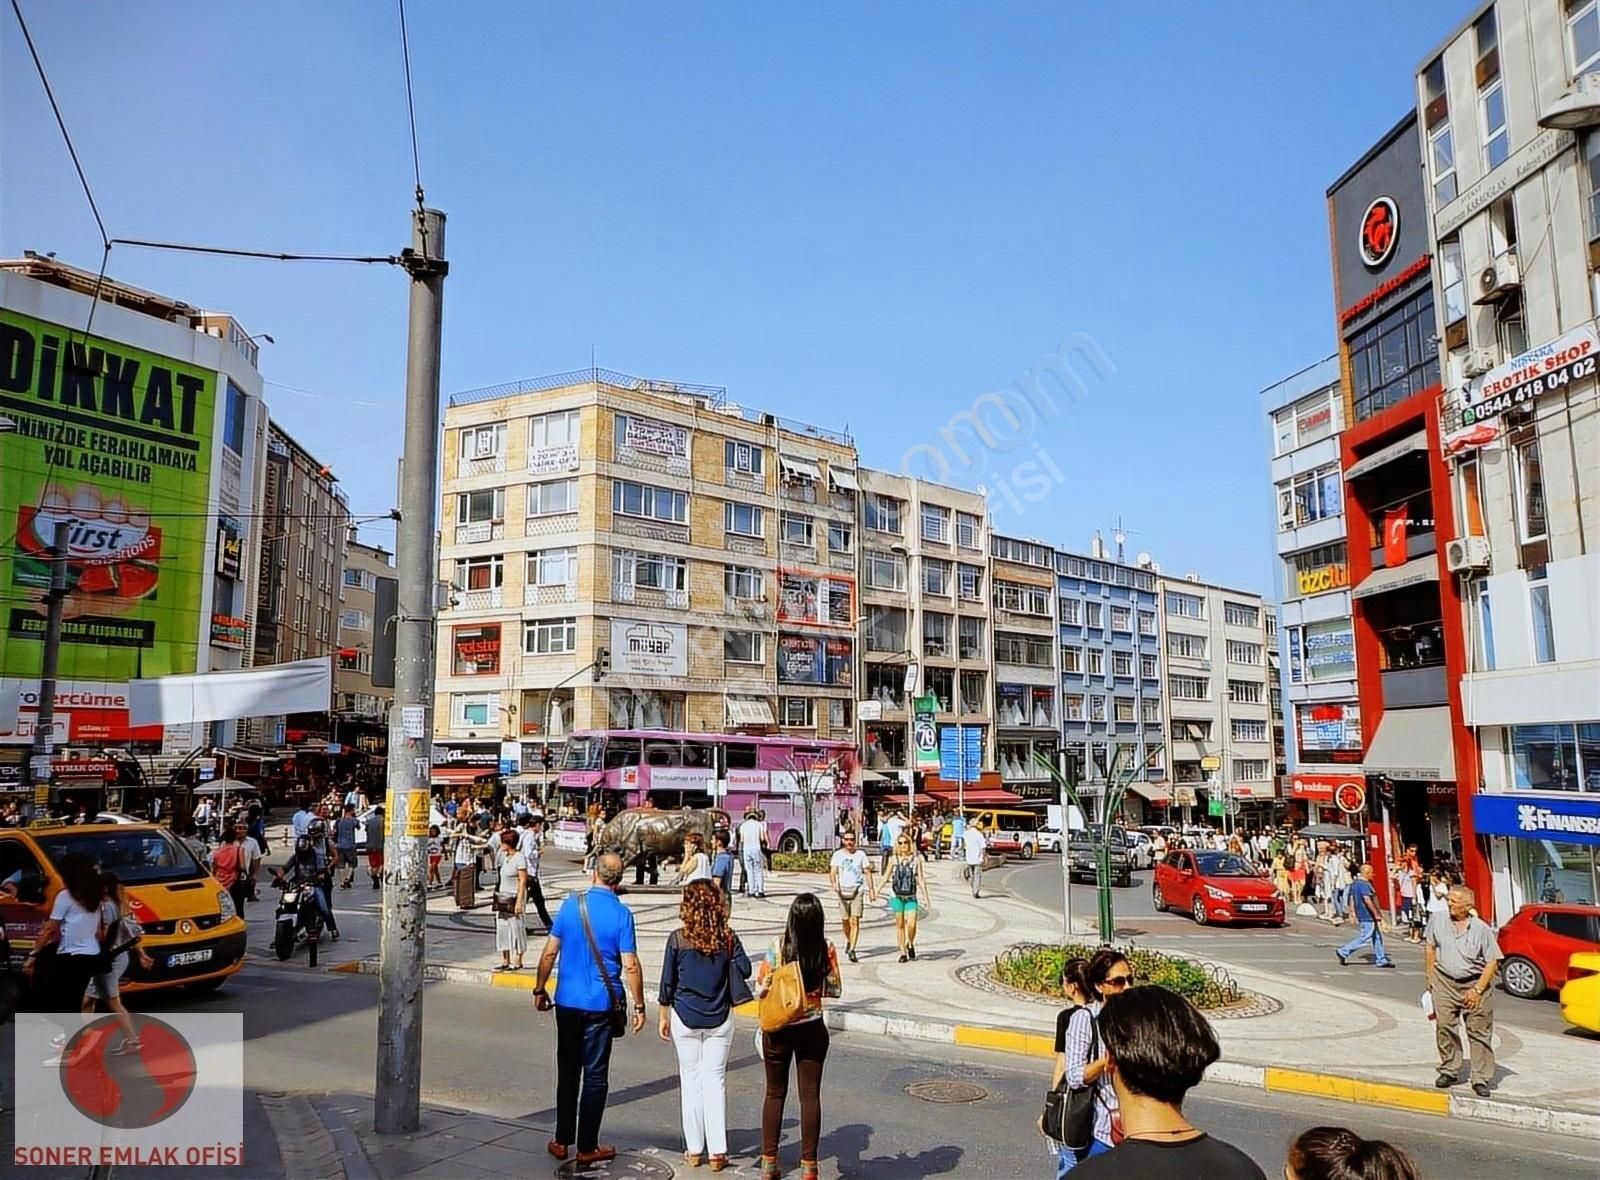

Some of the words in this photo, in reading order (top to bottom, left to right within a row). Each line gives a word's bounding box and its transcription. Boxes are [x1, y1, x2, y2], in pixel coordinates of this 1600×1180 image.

[1544, 340, 1592, 371] SHOP
[0, 321, 205, 435] DİKKAT
[1475, 393, 1512, 419] 0544
[1515, 379, 1544, 402] 418
[1547, 367, 1570, 389] 04
[1572, 357, 1597, 379] 02
[44, 444, 75, 469] YOL
[79, 452, 152, 484] AÇABİLİR
[90, 433, 198, 472] FERAHLAMAYA
